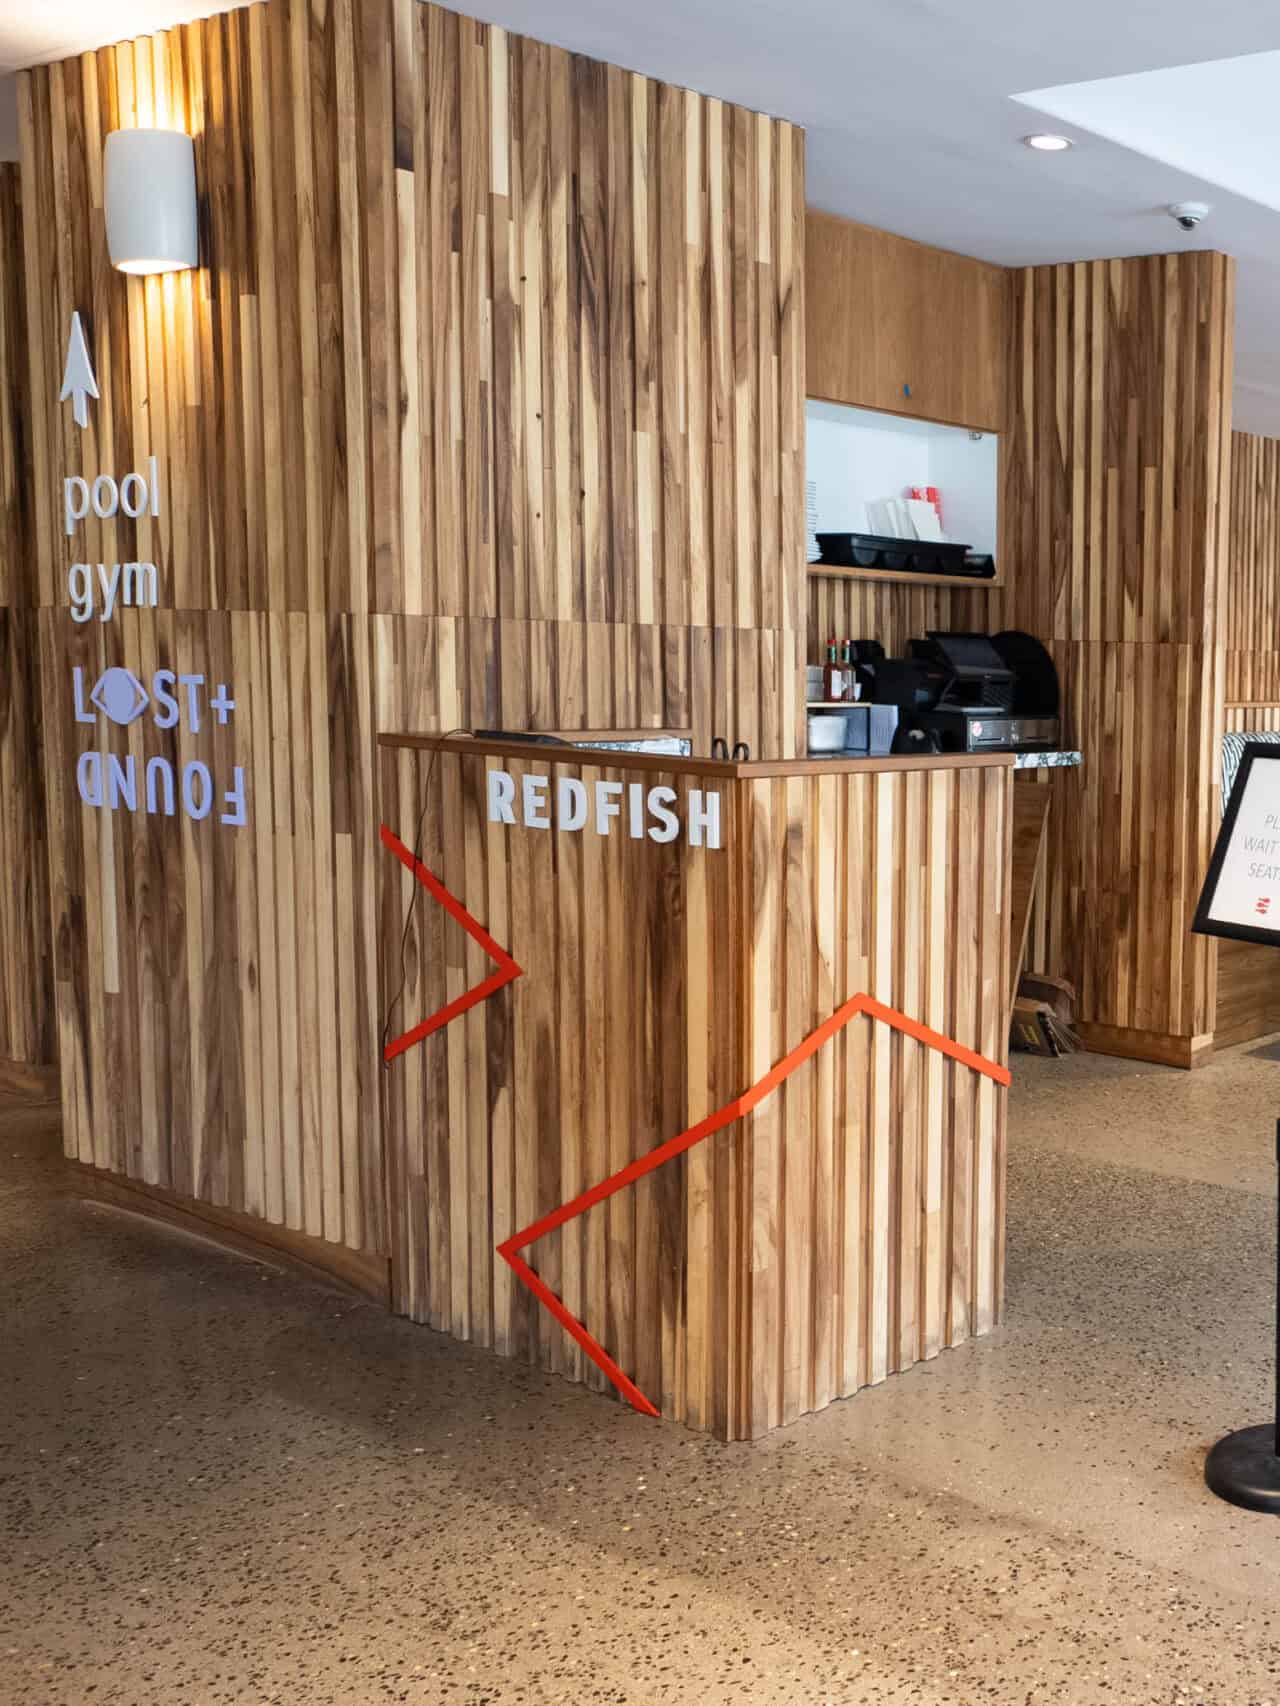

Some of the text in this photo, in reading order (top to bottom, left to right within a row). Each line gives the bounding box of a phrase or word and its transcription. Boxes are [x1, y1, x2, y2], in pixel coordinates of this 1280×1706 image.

[64, 456, 160, 535] pool
[68, 562, 158, 623] gym
[77, 751, 247, 827] FOUND
[487, 769, 721, 849] REDFISH
[1243, 836, 1280, 856] WAIT
